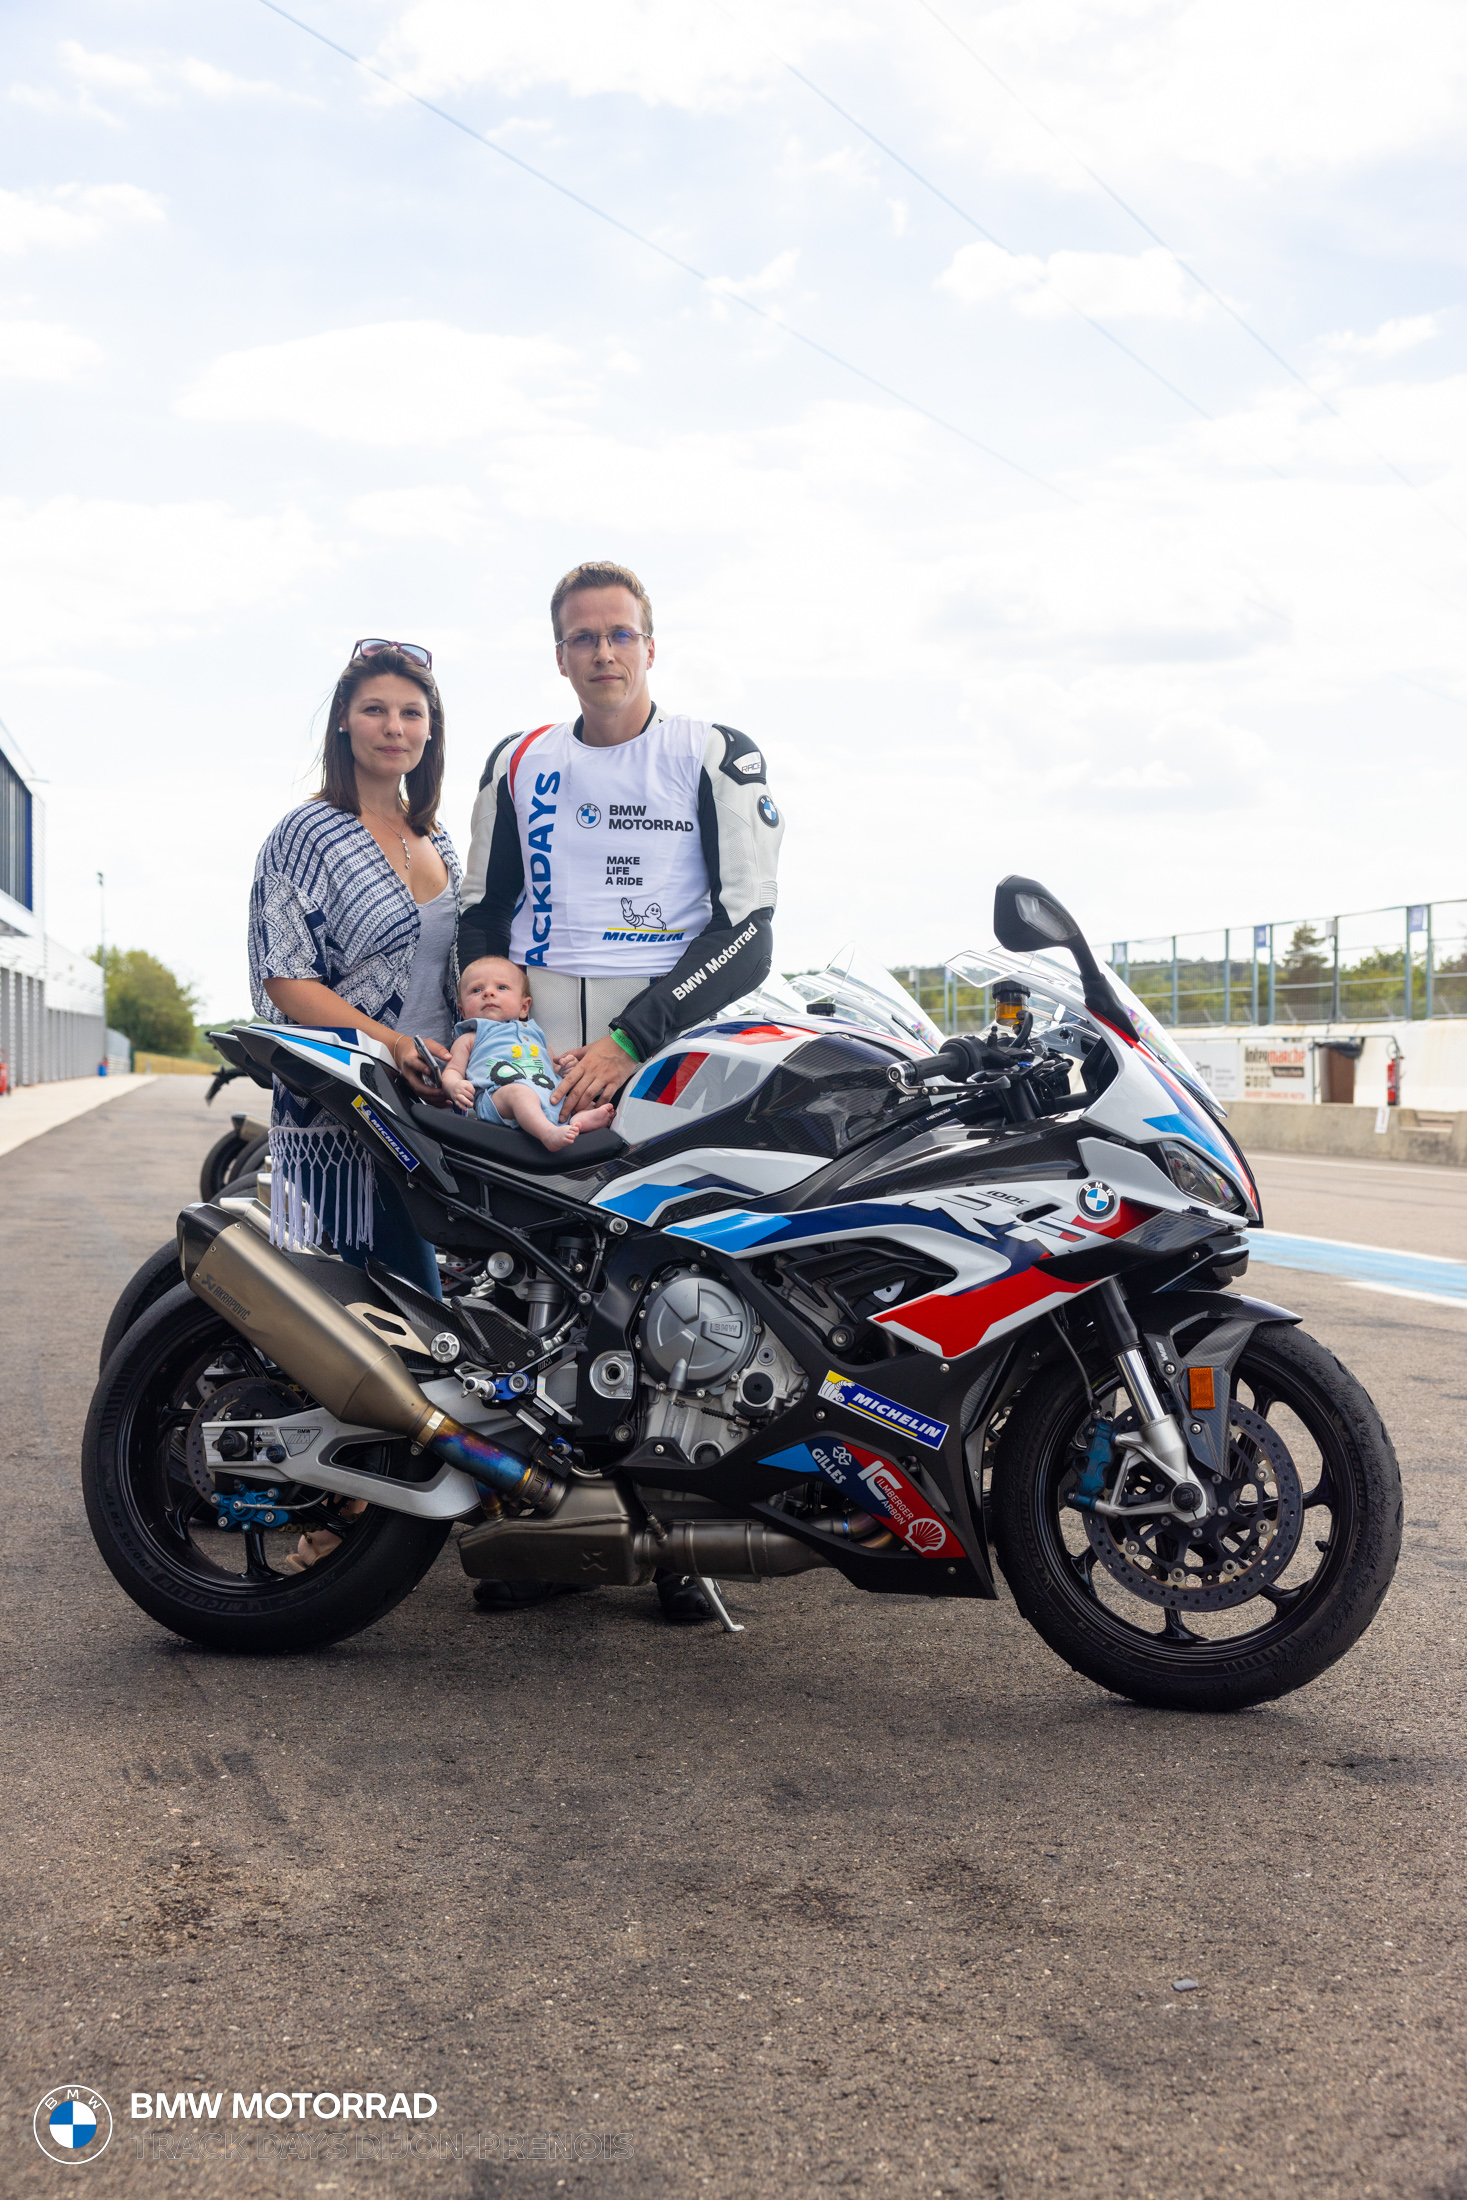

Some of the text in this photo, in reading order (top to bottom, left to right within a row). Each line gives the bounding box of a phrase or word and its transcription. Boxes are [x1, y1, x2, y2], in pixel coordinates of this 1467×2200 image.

[609, 805, 647, 816] BMW
[608, 819, 694, 832] MOTORRAD
[606, 856, 640, 865] MAKE
[606, 866, 630, 875] LIFE
[605, 877, 643, 886] A RIDE
[602, 931, 684, 943] MICHELIN
[671, 922, 758, 1001] BMW Motorrad
[371, 1119, 411, 1162] MICHELIN
[1083, 1182, 1115, 1198] BMW
[852, 1392, 941, 1438] MICHELIN
[811, 1448, 847, 1484] GILLES
[877, 1478, 915, 1520] ILMBERGER
[1020, 1492, 1043, 1569] MICHELIN
[104, 1492, 243, 1611] MICHELIN 190/55 ZR 17
